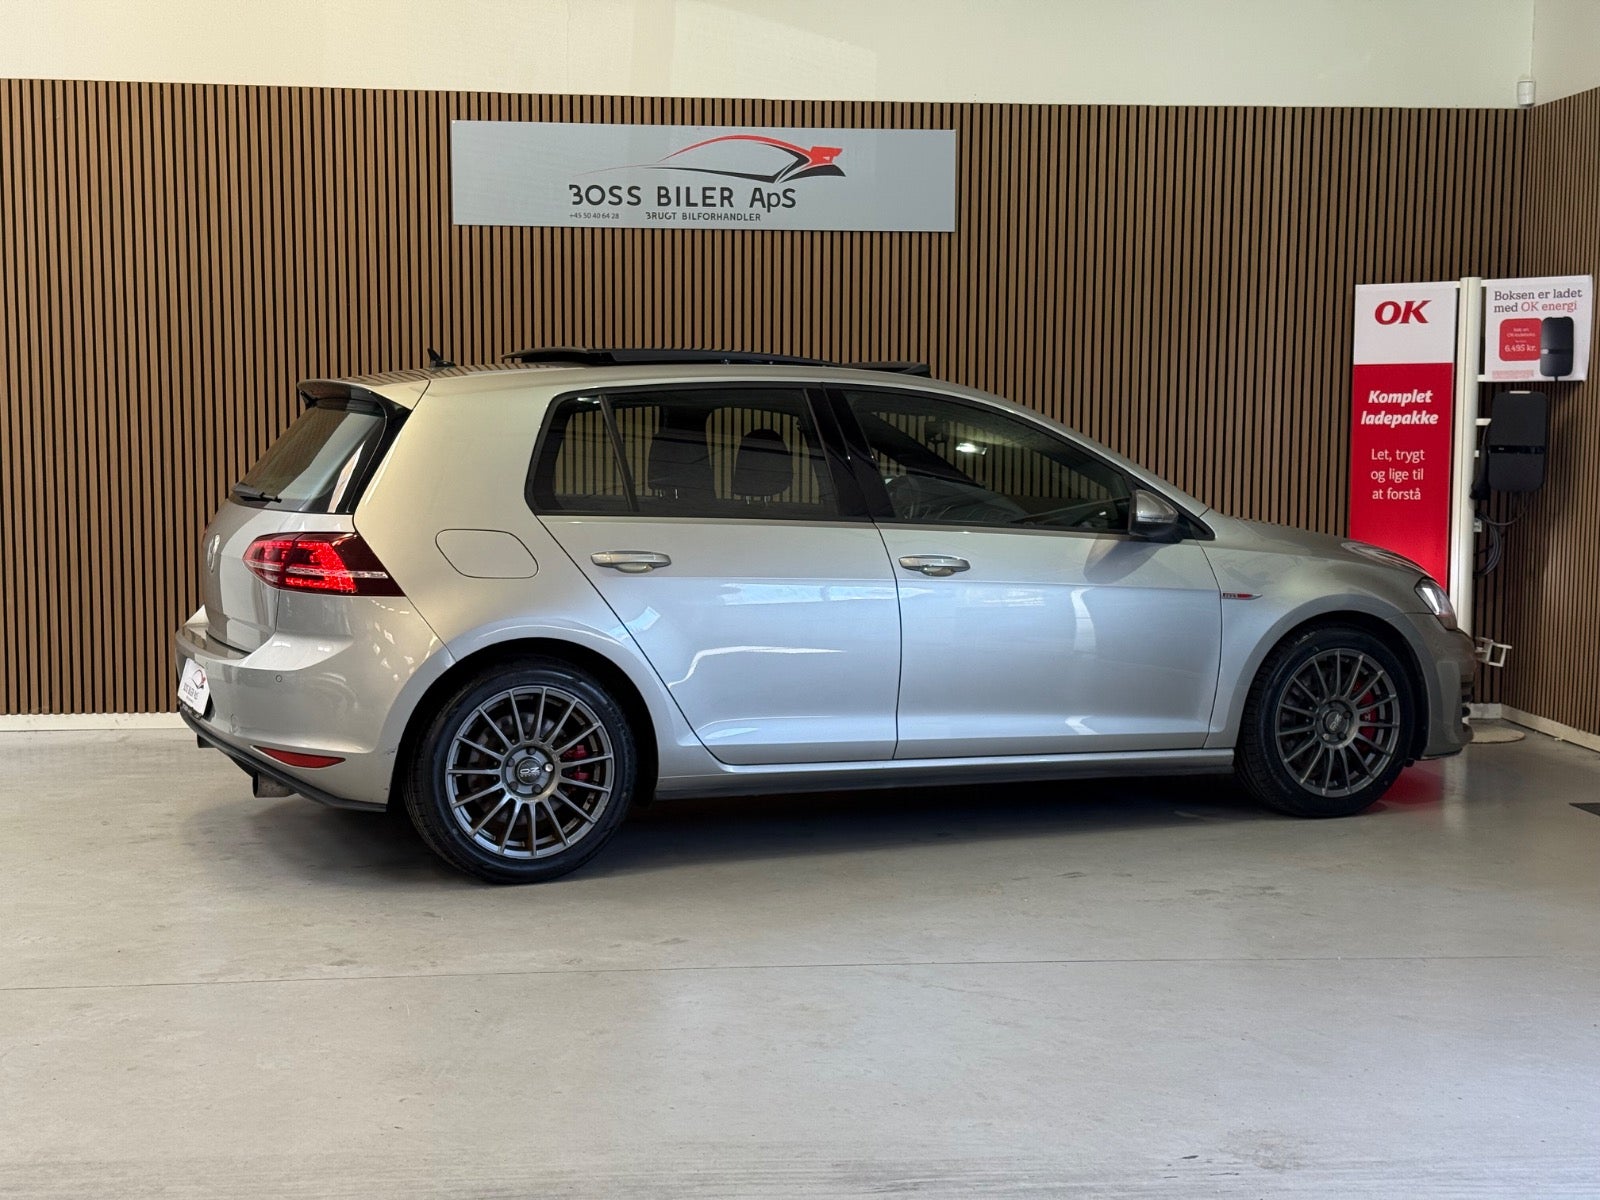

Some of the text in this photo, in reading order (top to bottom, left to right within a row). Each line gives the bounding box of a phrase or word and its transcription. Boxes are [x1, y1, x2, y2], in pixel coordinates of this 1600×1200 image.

[657, 186, 734, 208] BILER
[749, 188, 796, 213] ApS
[611, 212, 620, 220] 28
[682, 212, 761, 221] BILFORHANDLER
[1494, 288, 1583, 301] Boksen er ladet
[1374, 300, 1431, 325] OK
[1494, 300, 1577, 313] med OK energi
[1526, 344, 1537, 352] kr.
[1368, 389, 1433, 407] Komplet
[1360, 410, 1439, 428] ladepakke
[1371, 448, 1425, 464] Let, trygt
[1370, 467, 1424, 483] og lige til
[1372, 487, 1421, 500] at forstå
